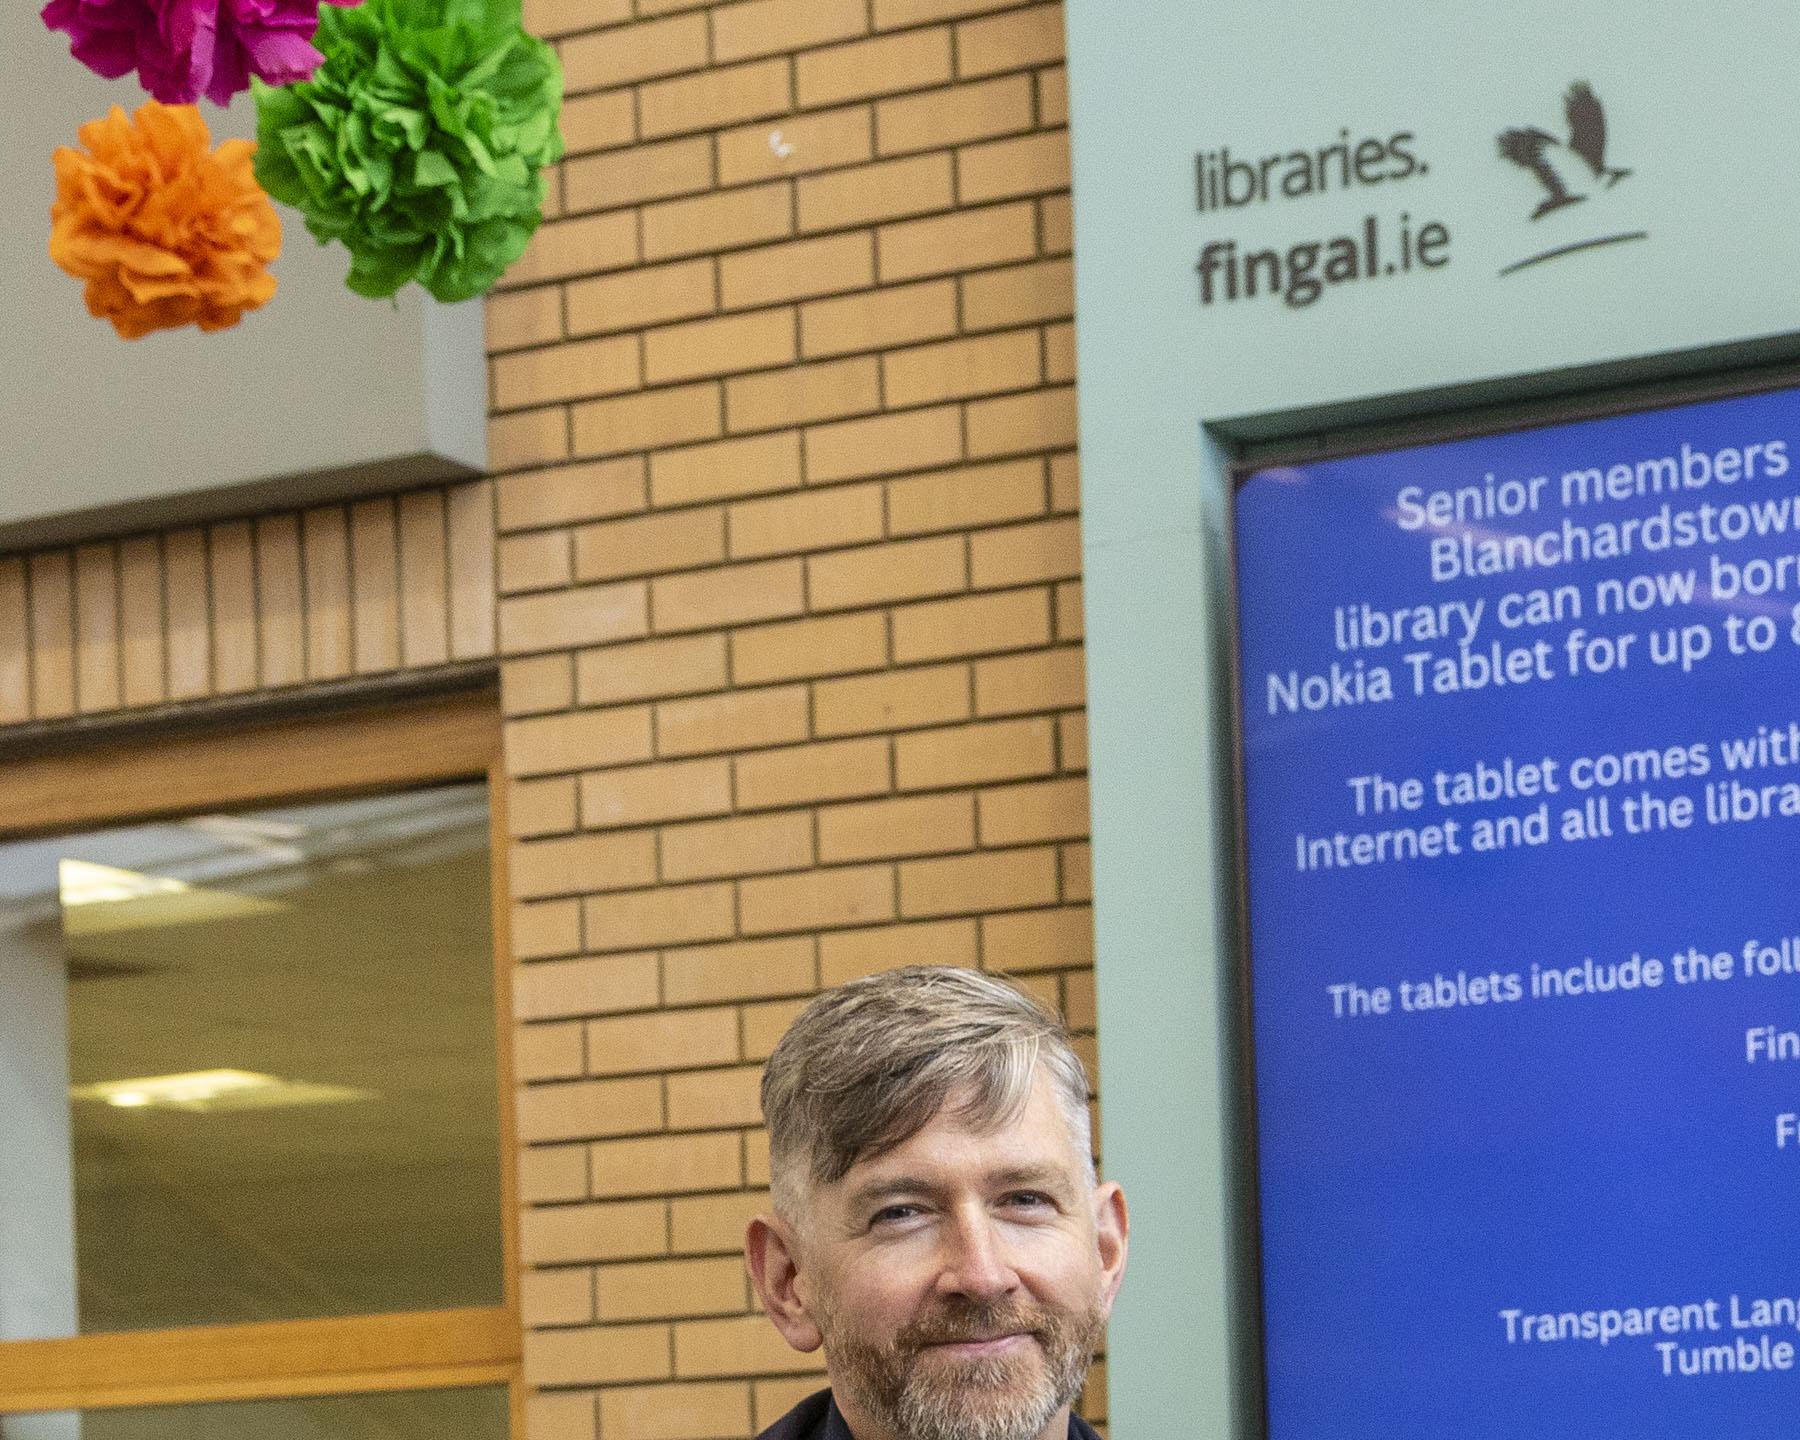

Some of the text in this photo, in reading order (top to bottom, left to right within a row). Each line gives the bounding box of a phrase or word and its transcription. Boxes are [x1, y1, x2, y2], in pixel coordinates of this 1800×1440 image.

[1195, 128, 1430, 213] libraries.
[1196, 212, 1451, 310] fingal.ie
[1397, 474, 1546, 530] Senior
[1561, 438, 1788, 508] members
[1335, 599, 1485, 651] library
[1498, 586, 1581, 628] can
[1597, 569, 1696, 614] now
[1267, 658, 1393, 715] Nokia
[1405, 638, 1555, 696] Tablet
[1567, 629, 1636, 677] for
[1650, 620, 1712, 670] up
[1727, 609, 1777, 654] to
[1348, 774, 1424, 817] The
[1435, 757, 1559, 808] tablet
[1570, 737, 1711, 788] comes
[1296, 825, 1461, 873] Internet
[1472, 805, 1550, 851] and
[1561, 795, 1611, 842] all
[1623, 788, 1694, 835] the
[1328, 980, 1392, 1018] The
[1400, 970, 1522, 1013] tablets
[1531, 956, 1664, 1000] include
[1673, 950, 1734, 986] the
[1500, 1300, 1720, 1346] Transparent
[1656, 1332, 1794, 1377] Tumble
